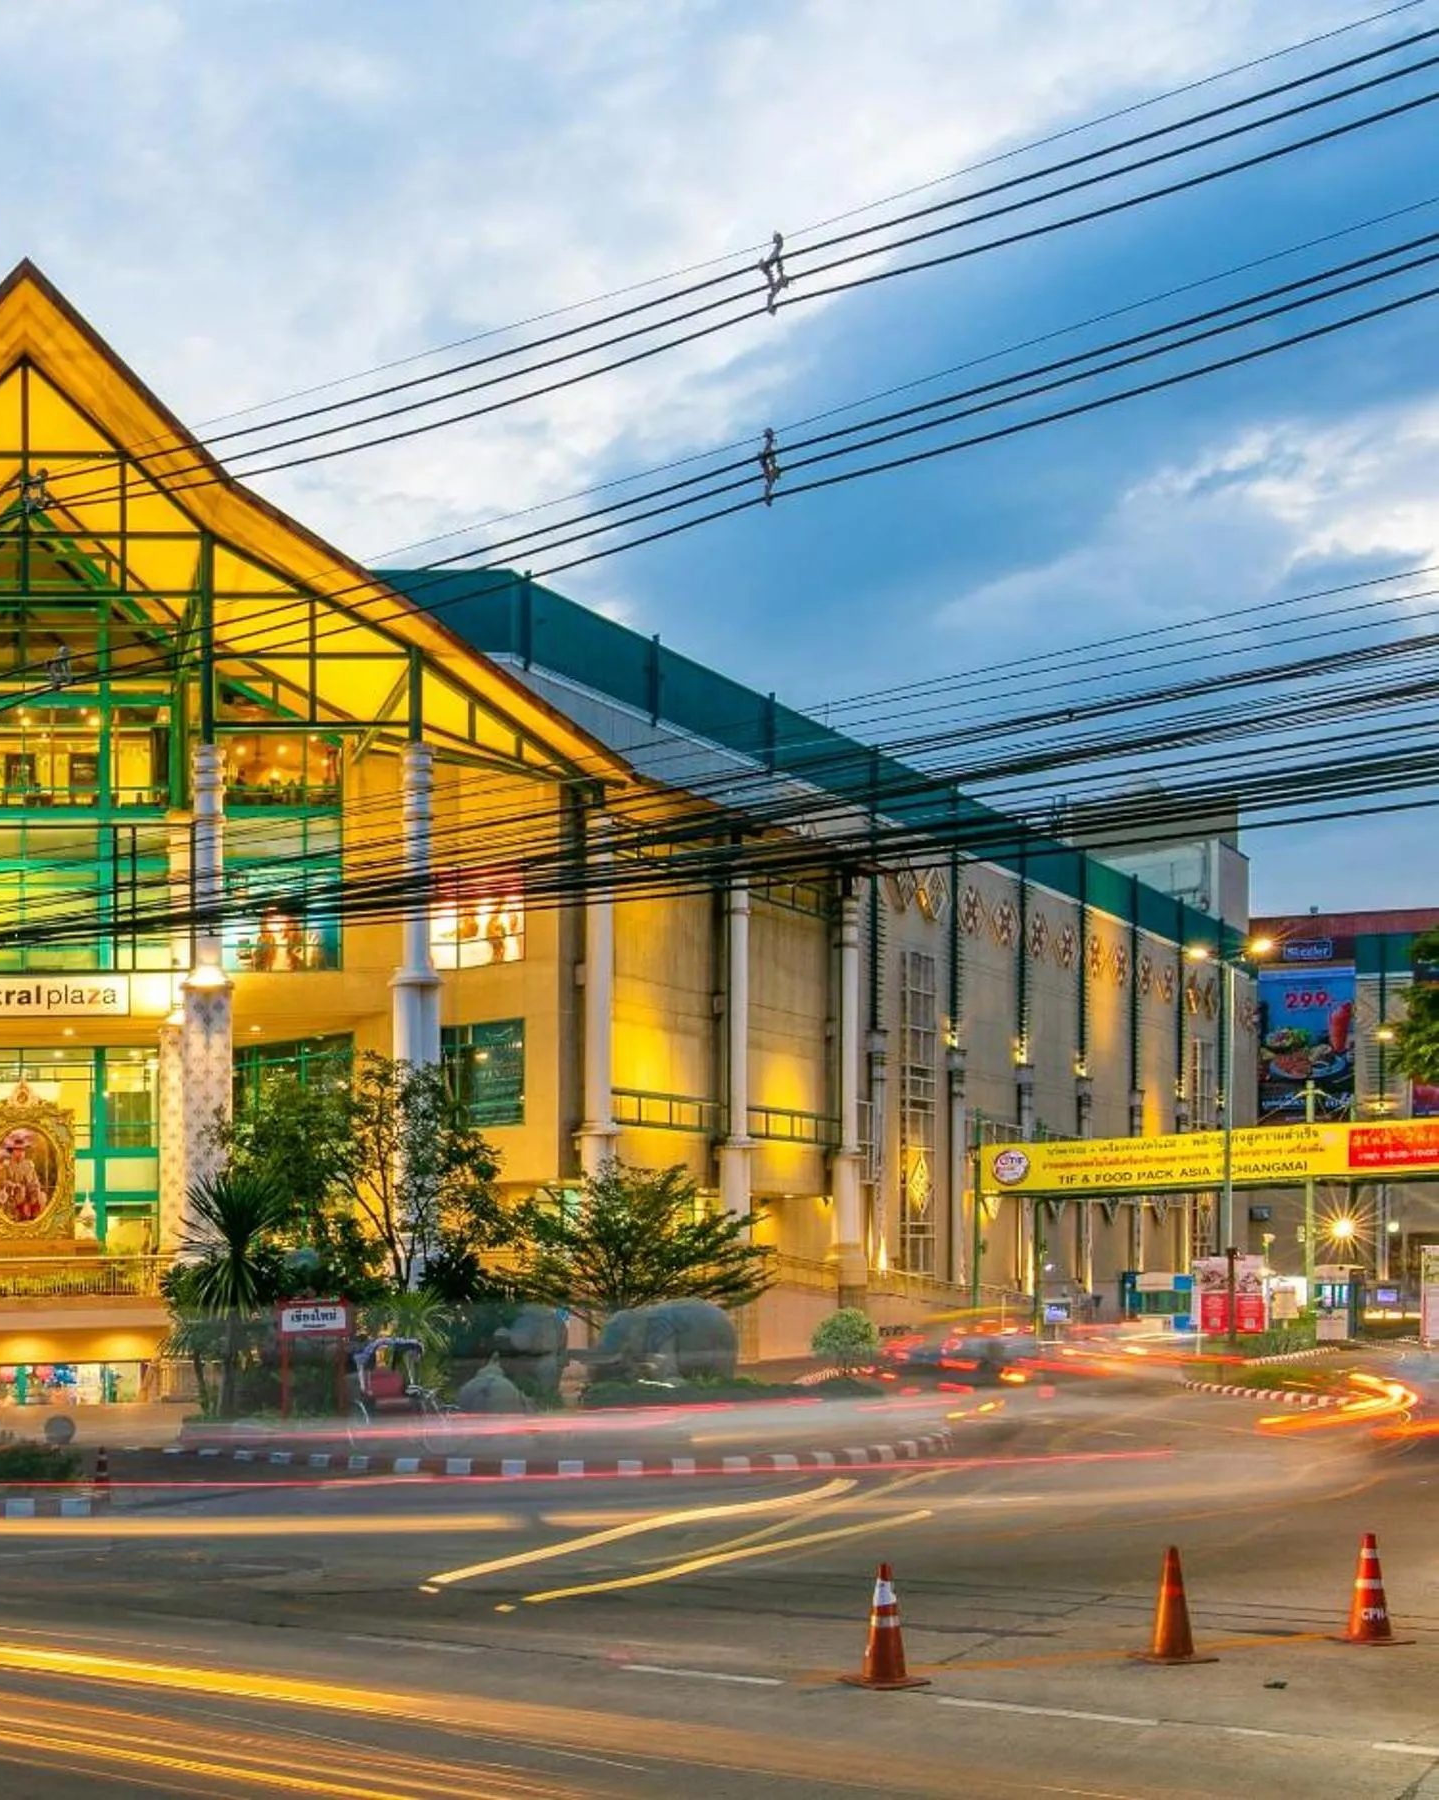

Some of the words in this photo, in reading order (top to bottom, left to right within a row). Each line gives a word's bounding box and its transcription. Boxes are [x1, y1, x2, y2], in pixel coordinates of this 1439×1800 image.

[1058, 1174, 1077, 1185] TIF
[1081, 1173, 1091, 1184] &
[1095, 1172, 1133, 1184] FOOD
[1137, 1170, 1174, 1182] PACK
[1180, 1167, 1211, 1179] ASIA
